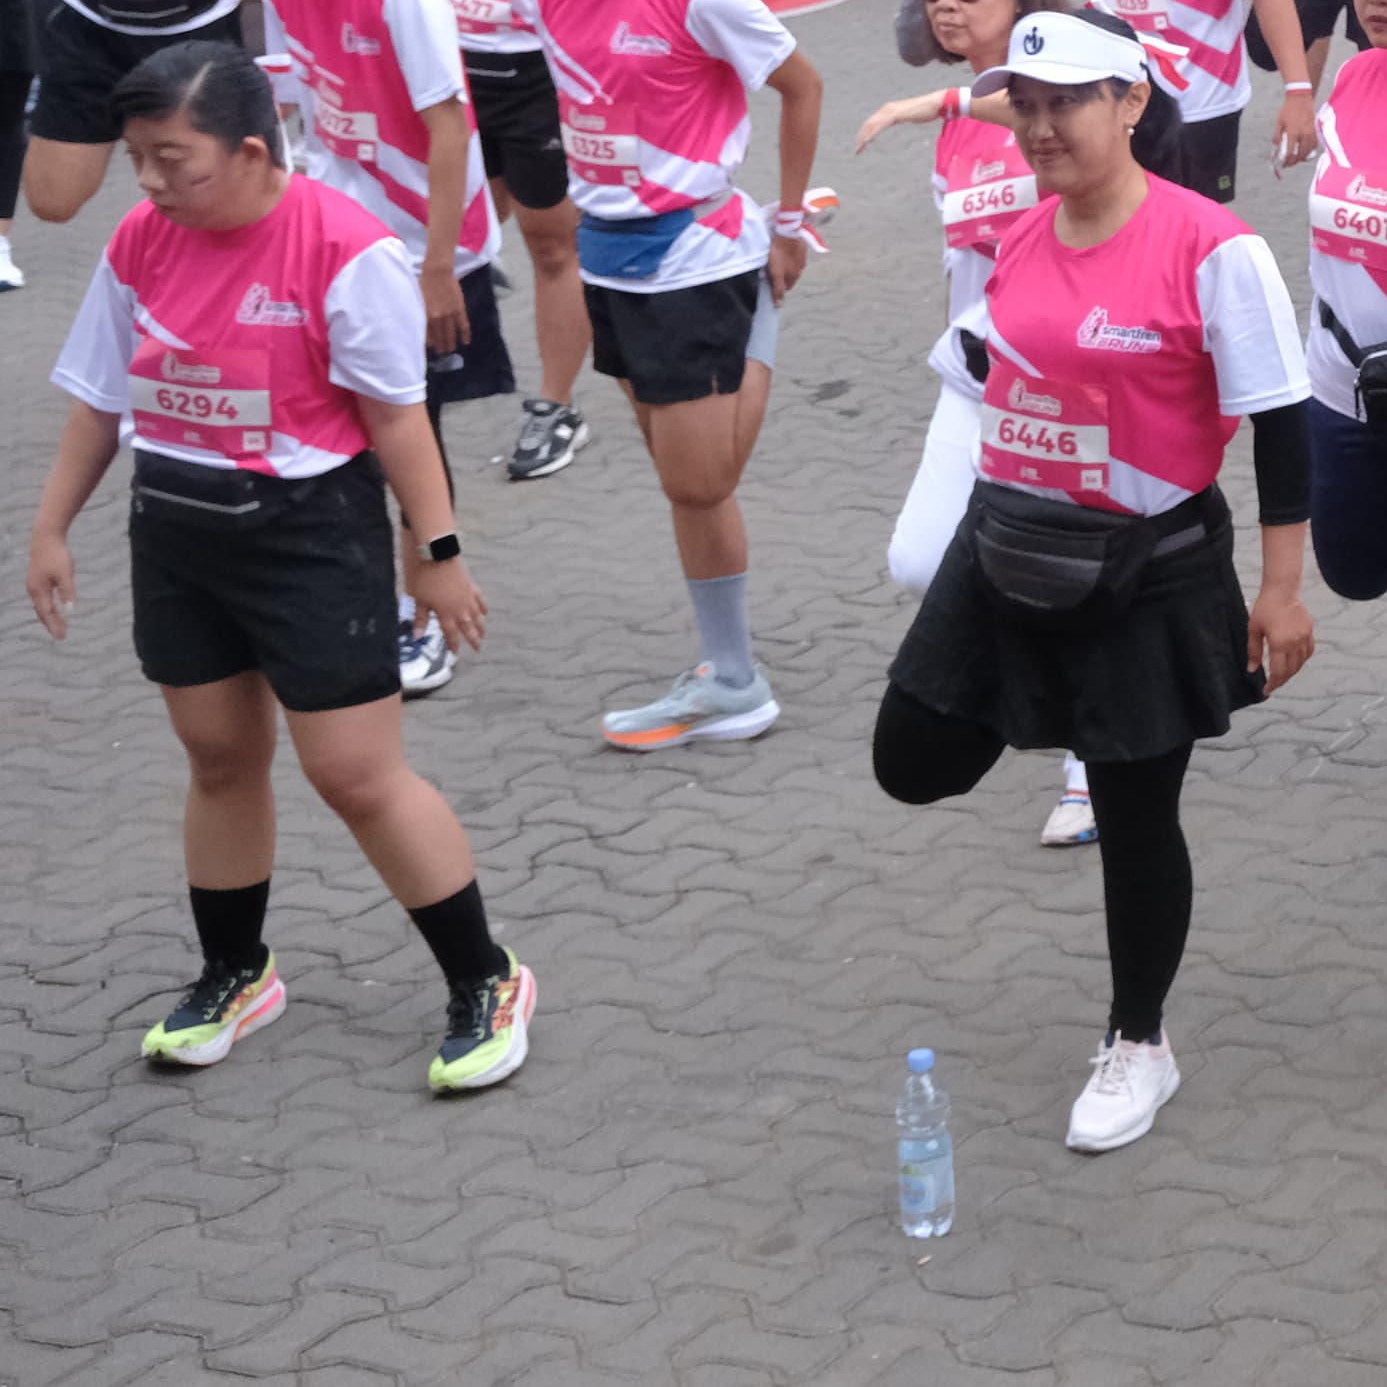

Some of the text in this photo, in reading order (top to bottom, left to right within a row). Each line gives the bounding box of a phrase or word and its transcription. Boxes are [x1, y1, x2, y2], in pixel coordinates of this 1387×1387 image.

[962, 188, 1018, 215] 6346
[1102, 325, 1162, 344] smartfren
[156, 387, 239, 421] 6294
[999, 418, 1078, 456] 6446
